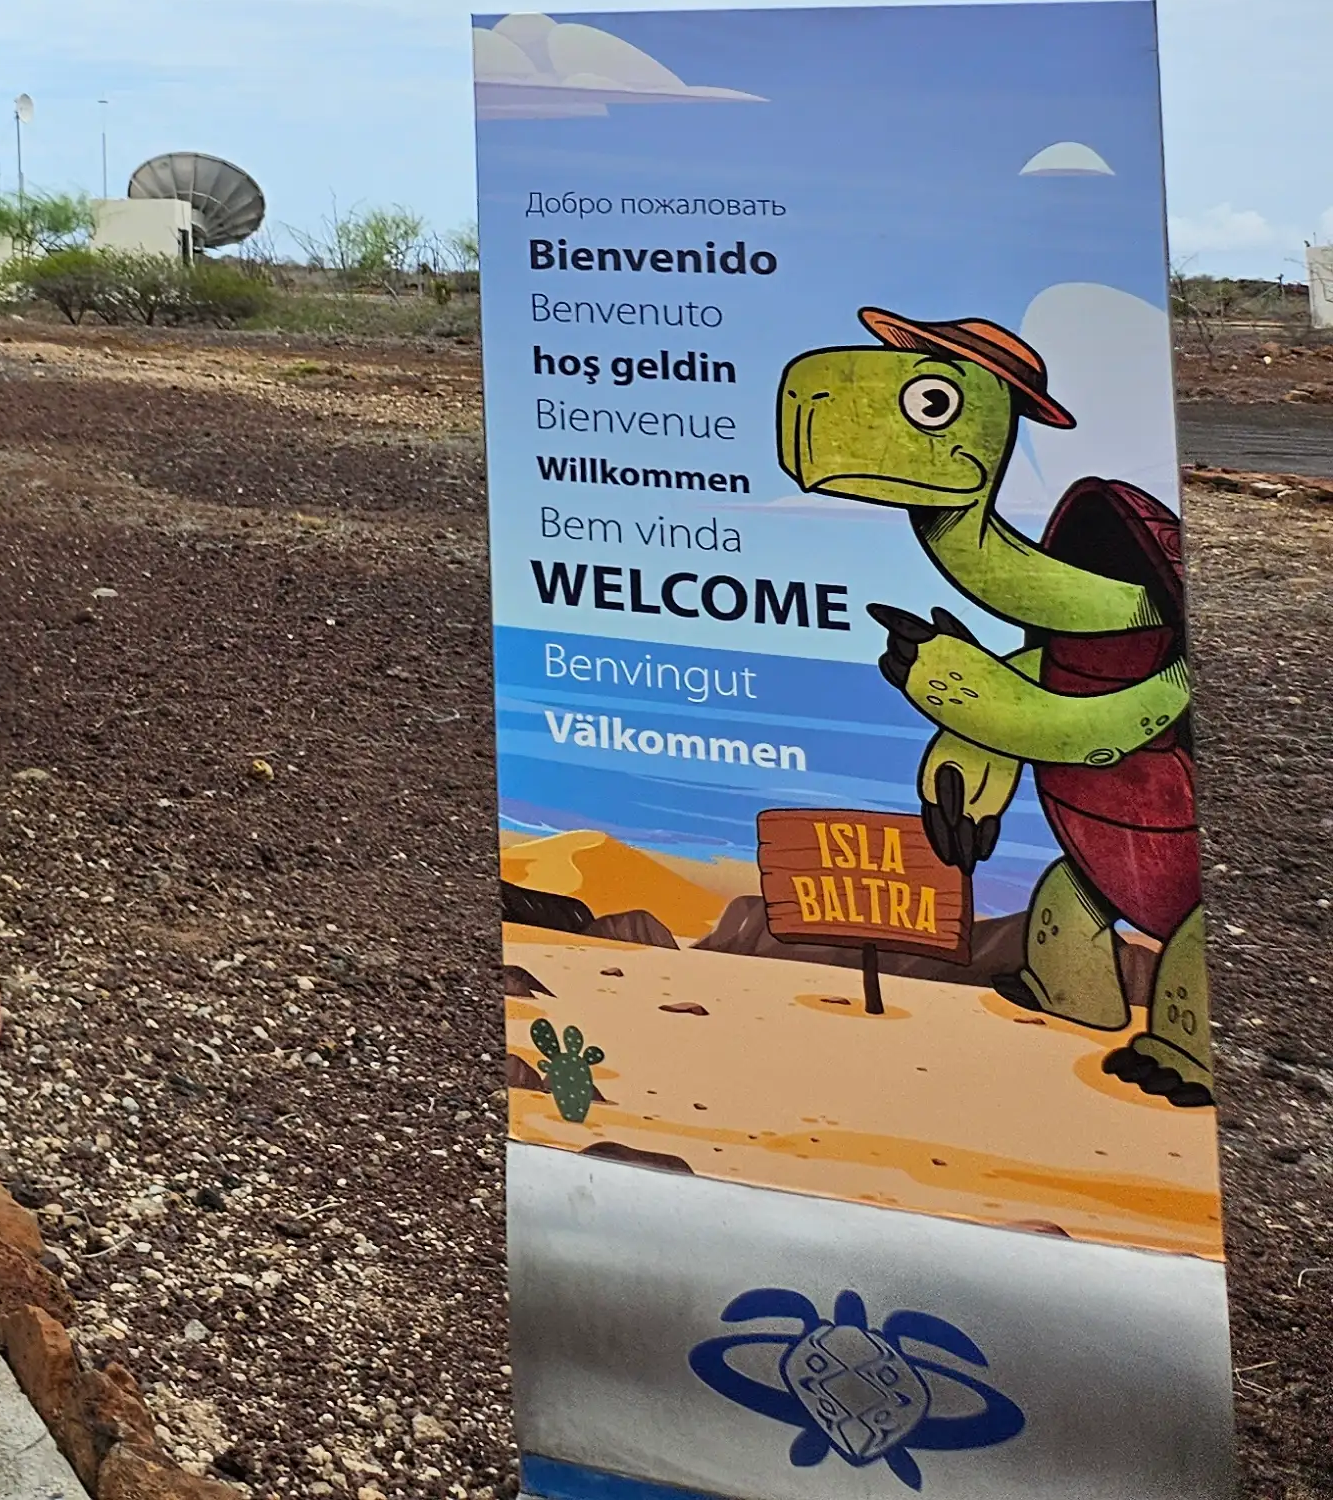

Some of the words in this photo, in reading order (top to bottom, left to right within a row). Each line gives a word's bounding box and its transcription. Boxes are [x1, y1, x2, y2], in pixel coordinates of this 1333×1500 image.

[526, 191, 613, 219] Добро
[621, 197, 787, 217] пожаловать
[529, 238, 778, 276] Bienvenido
[531, 293, 723, 328] Benvenuto
[533, 345, 601, 384] hoş
[610, 350, 737, 386] geldin
[536, 398, 737, 440] Bienvenue
[536, 456, 751, 494] Willkommen
[541, 506, 623, 544] Bem
[634, 516, 742, 553] vinda
[530, 559, 851, 631] WELCOME
[544, 643, 758, 703] Benvingut
[544, 710, 808, 771] Välkommen
[813, 822, 906, 875] ISLA
[791, 876, 938, 935] BALTRA
